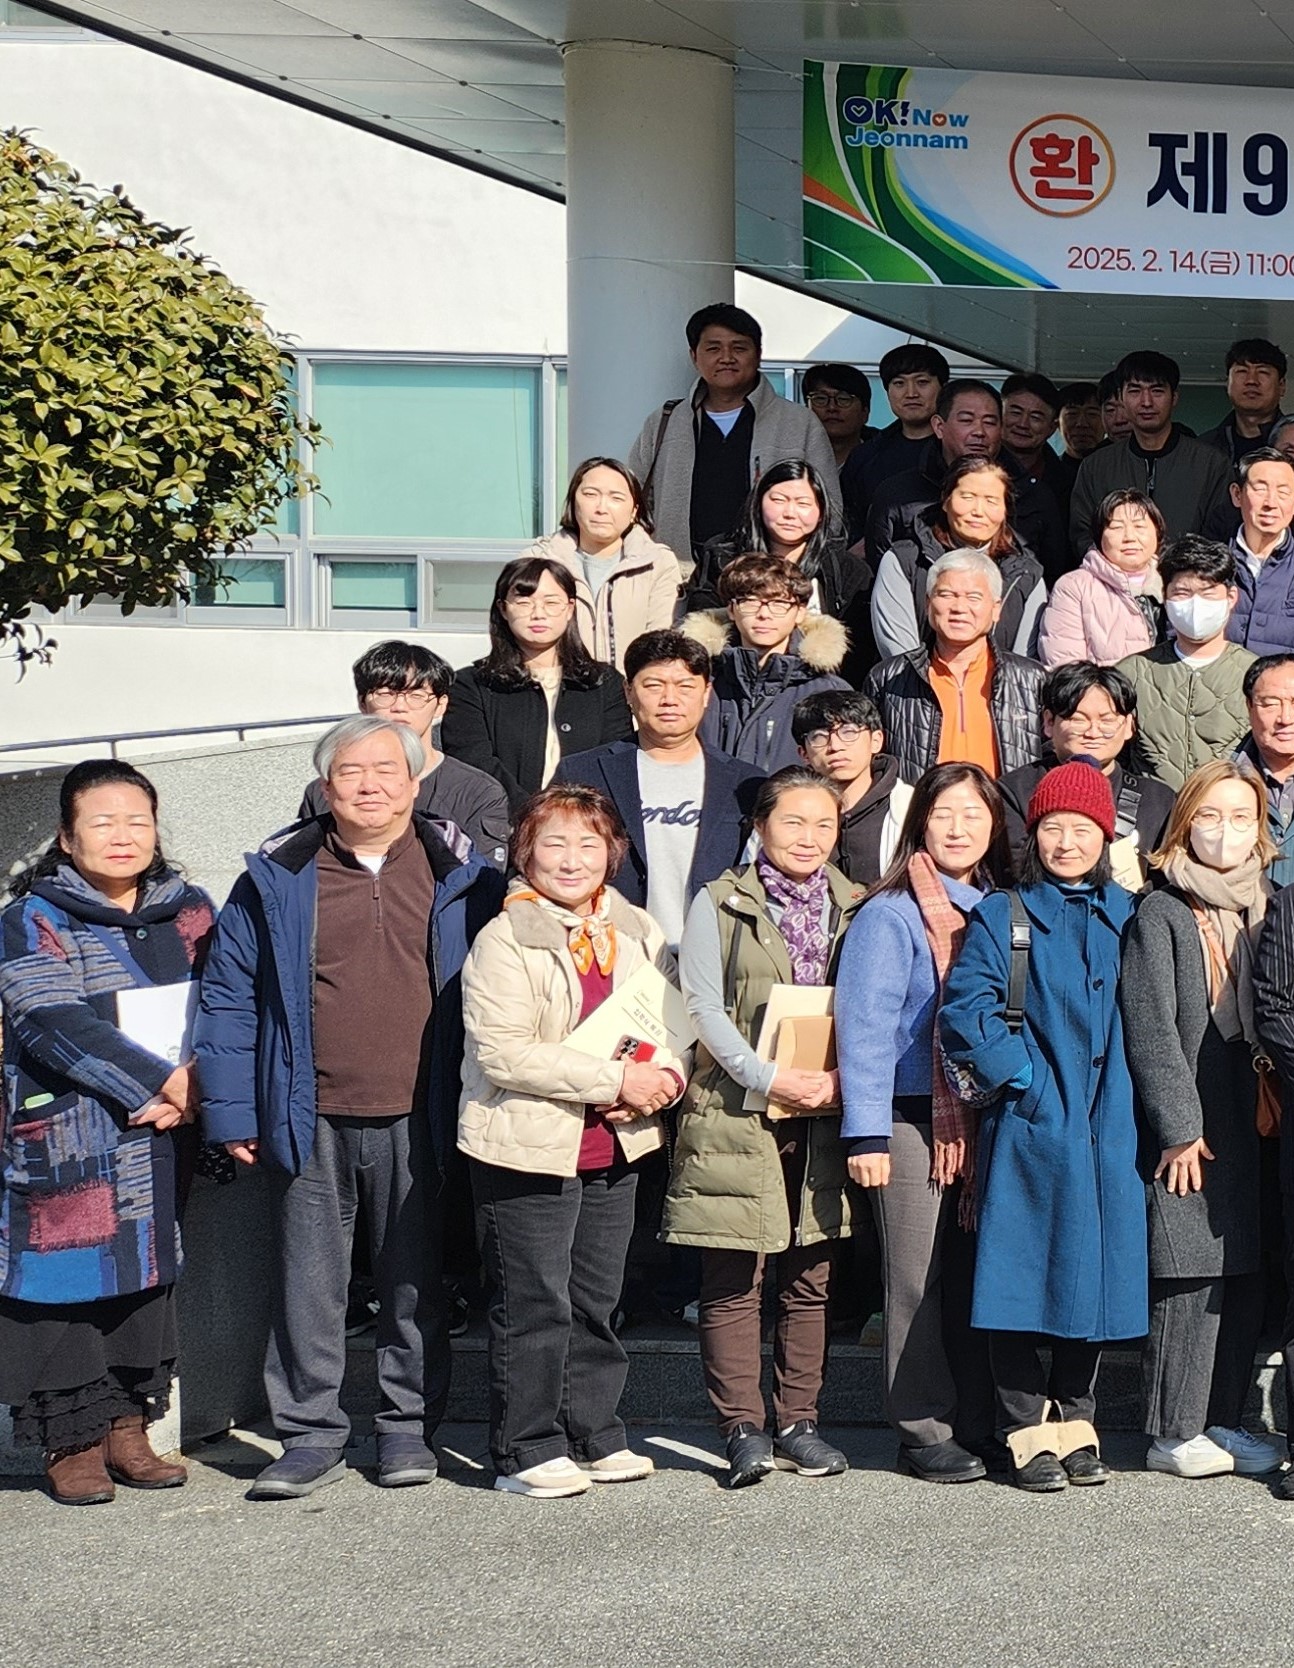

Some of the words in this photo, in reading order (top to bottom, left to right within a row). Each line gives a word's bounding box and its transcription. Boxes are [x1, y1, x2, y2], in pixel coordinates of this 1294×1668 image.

[912, 109, 969, 127] Now
[845, 126, 968, 149] Jeonnam
[1028, 132, 1100, 201] 환
[1067, 246, 1137, 272] 2025.
[1142, 248, 1163, 273] 2.
